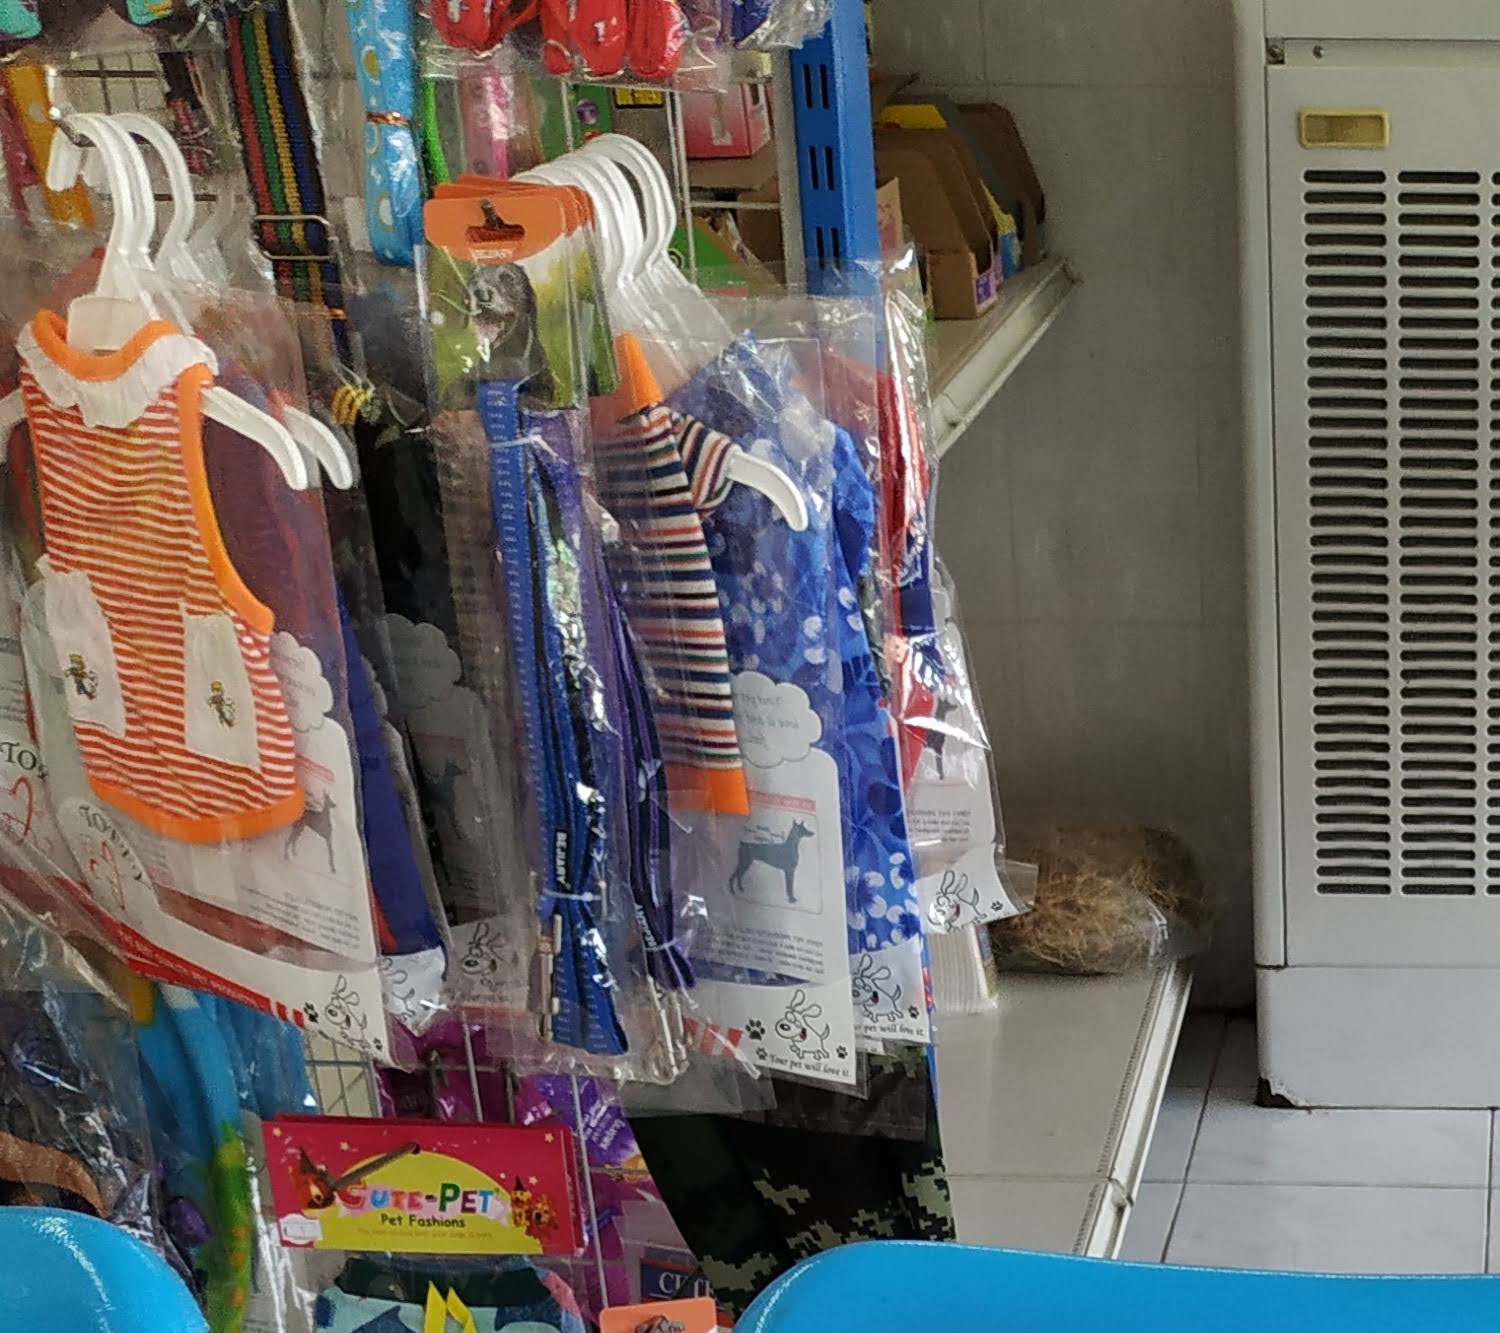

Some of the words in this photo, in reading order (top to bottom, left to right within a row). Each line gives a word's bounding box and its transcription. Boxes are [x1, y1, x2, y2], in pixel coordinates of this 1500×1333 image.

[338, 1180, 494, 1214] CUTE-PET
[381, 1213, 402, 1226] Pet
[408, 1215, 466, 1228] Fashions
